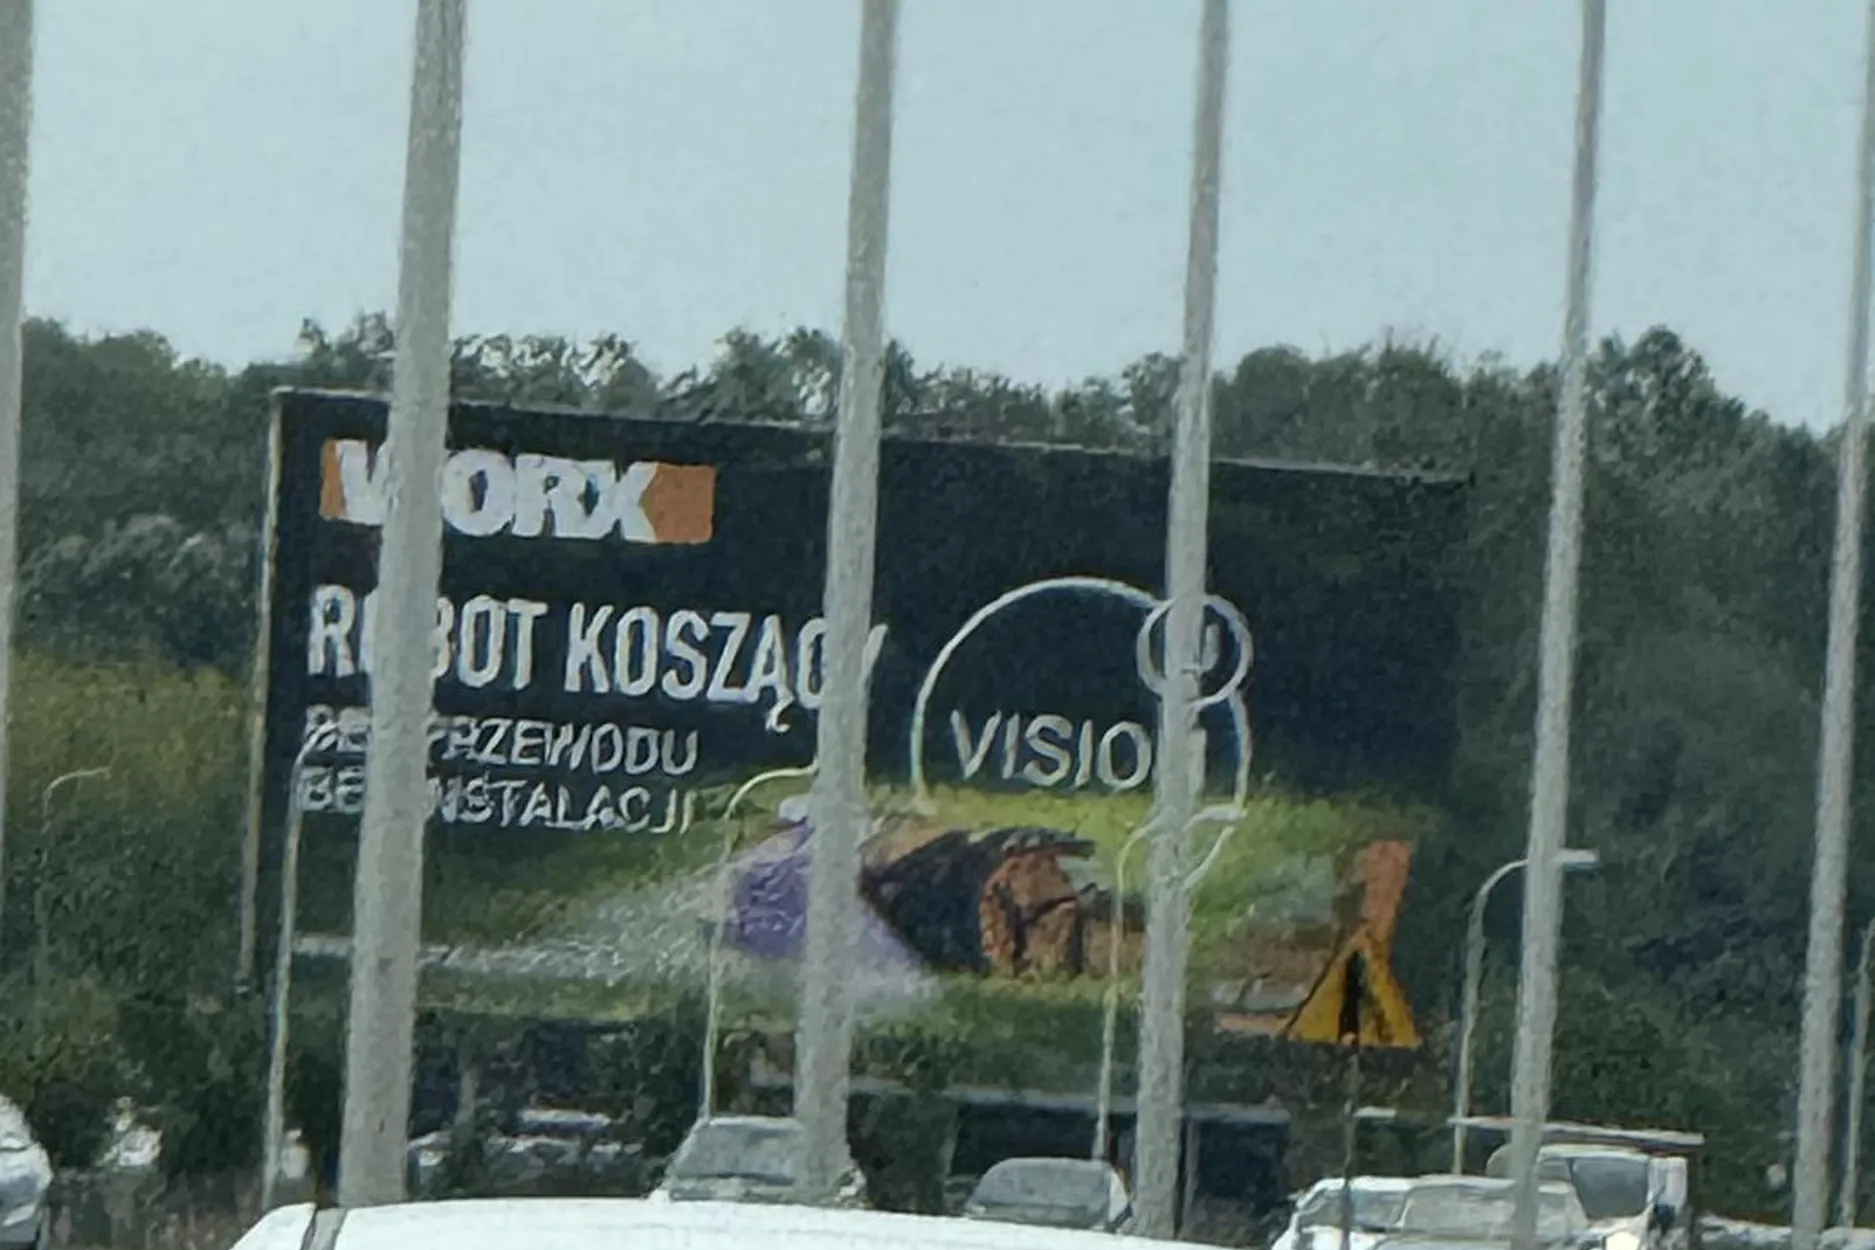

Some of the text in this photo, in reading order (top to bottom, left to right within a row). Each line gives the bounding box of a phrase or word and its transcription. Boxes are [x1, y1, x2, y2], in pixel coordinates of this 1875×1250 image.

[307, 584, 547, 690] RBOT
[950, 708, 1206, 793] VISIO
[425, 776, 697, 834] NSTALACJI
